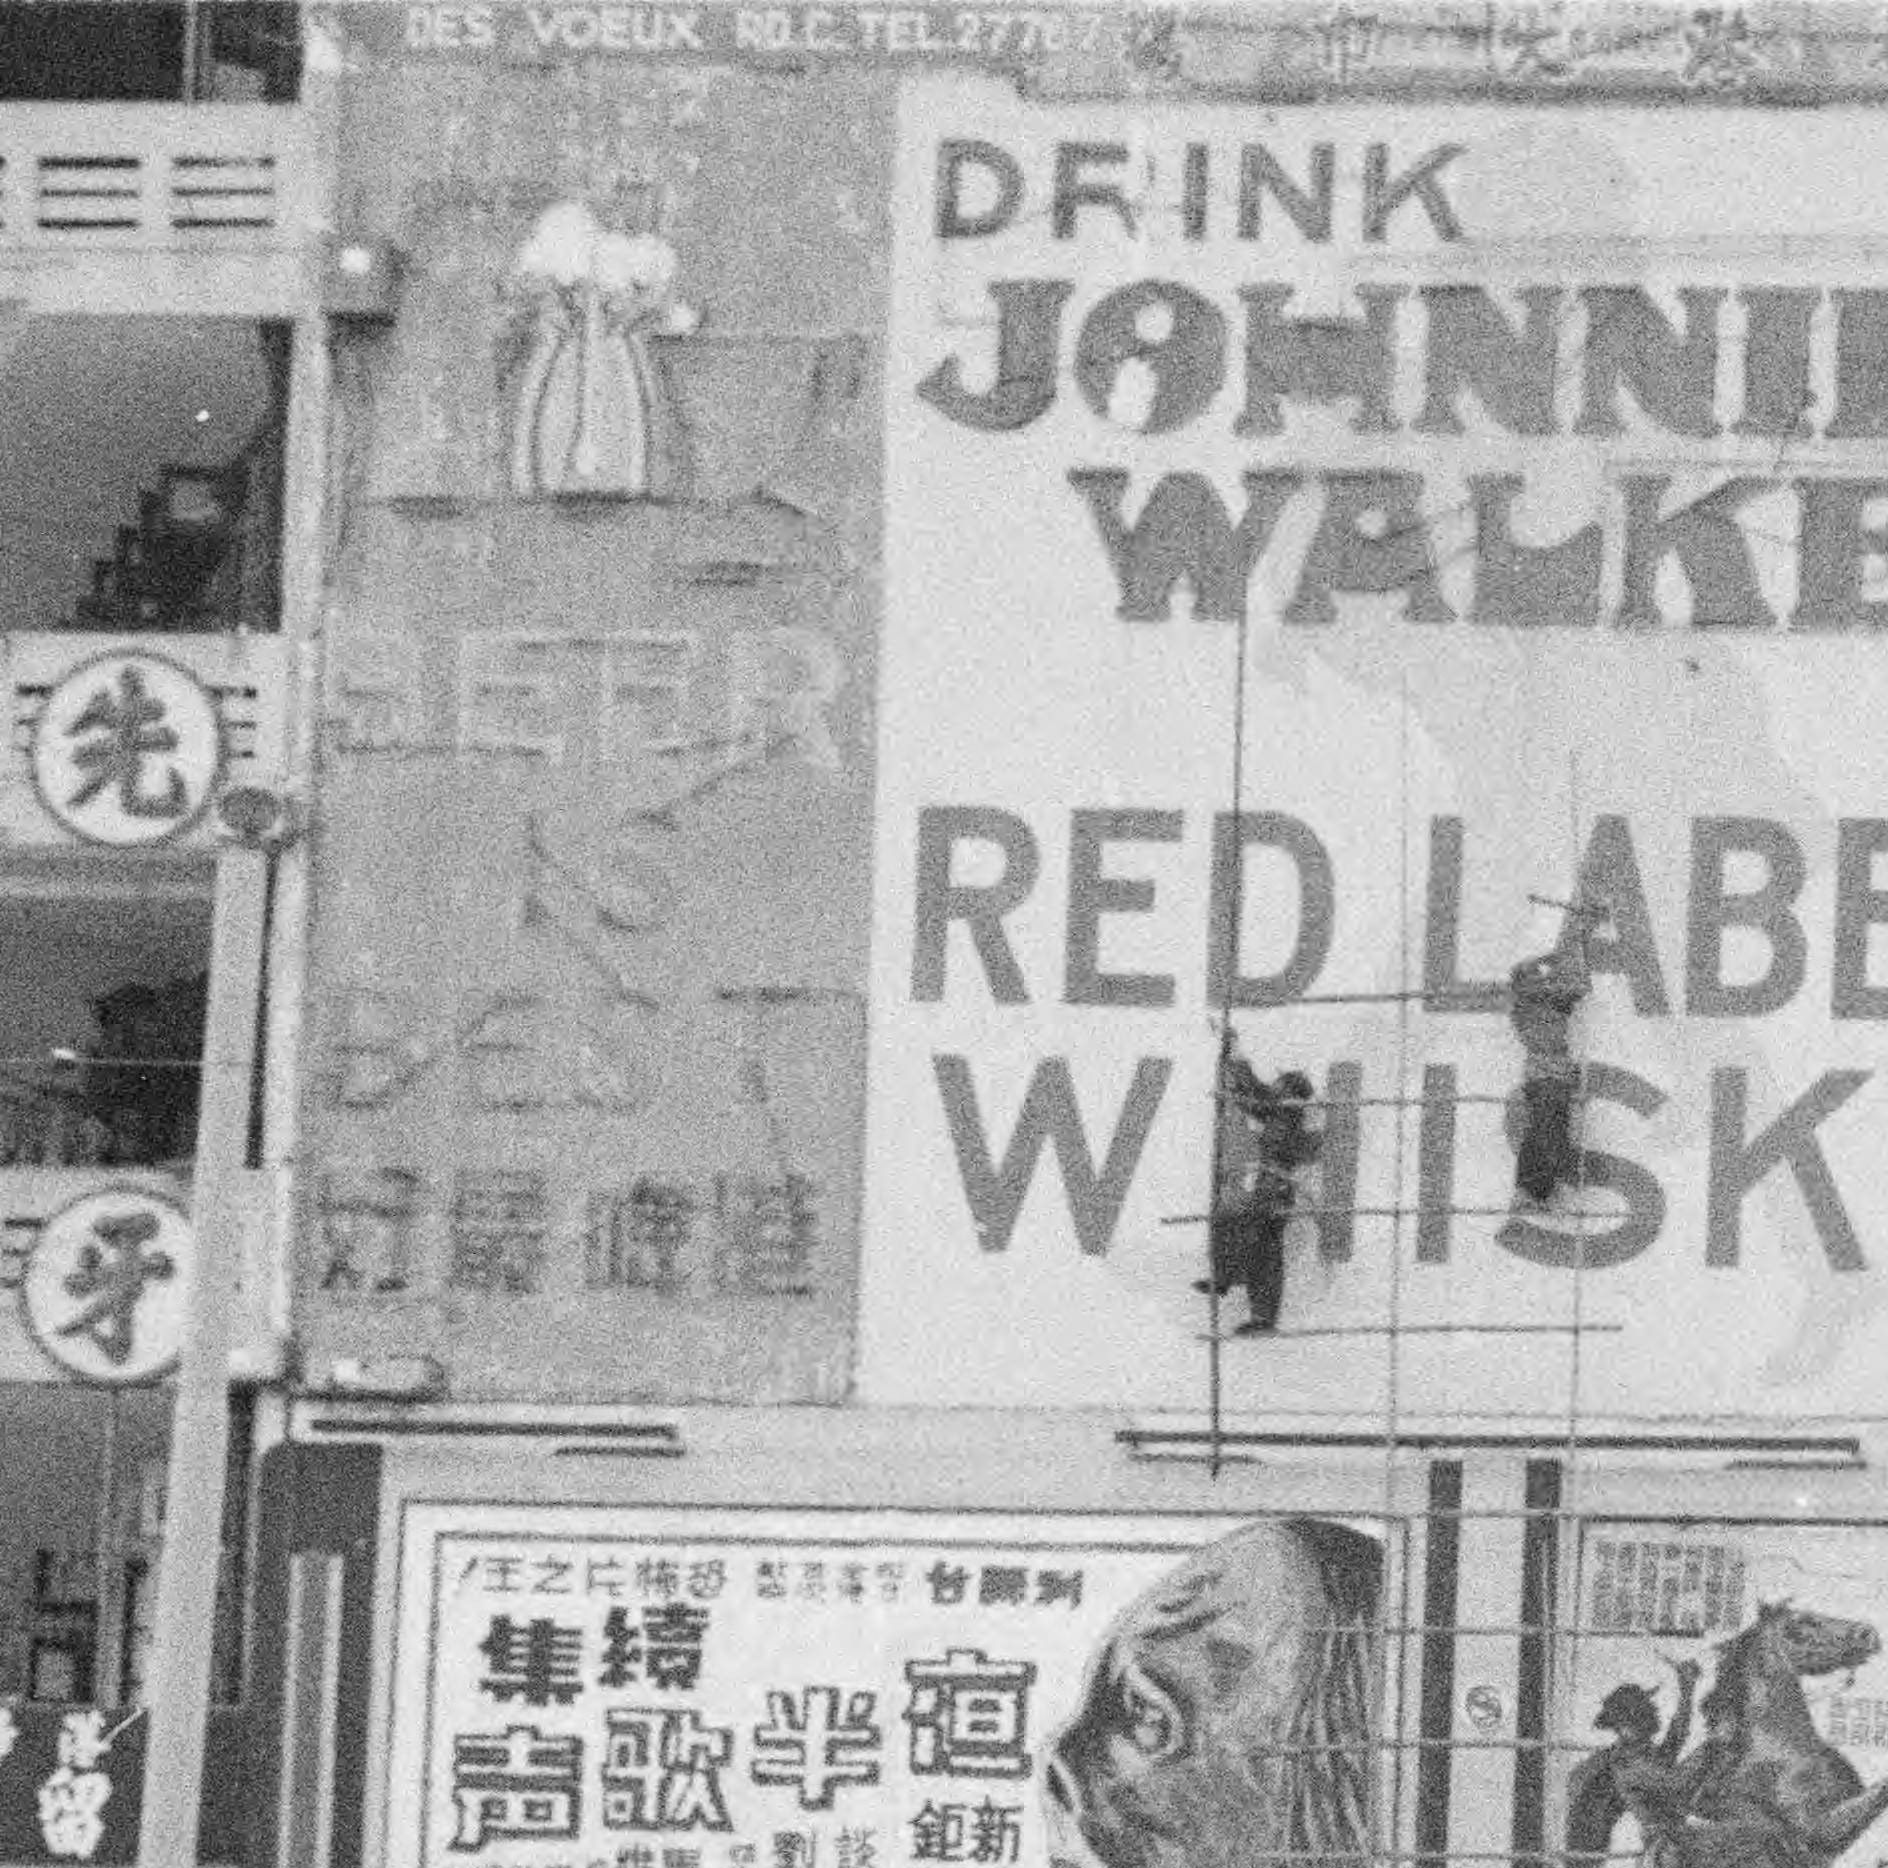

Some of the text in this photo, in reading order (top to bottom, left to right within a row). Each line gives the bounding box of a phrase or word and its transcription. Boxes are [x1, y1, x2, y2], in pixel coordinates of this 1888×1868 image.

[405, 8, 497, 51] DES
[528, 8, 703, 51] VOEUX
[935, 138, 1468, 245] DRINK
[911, 805, 1335, 1009] RED
